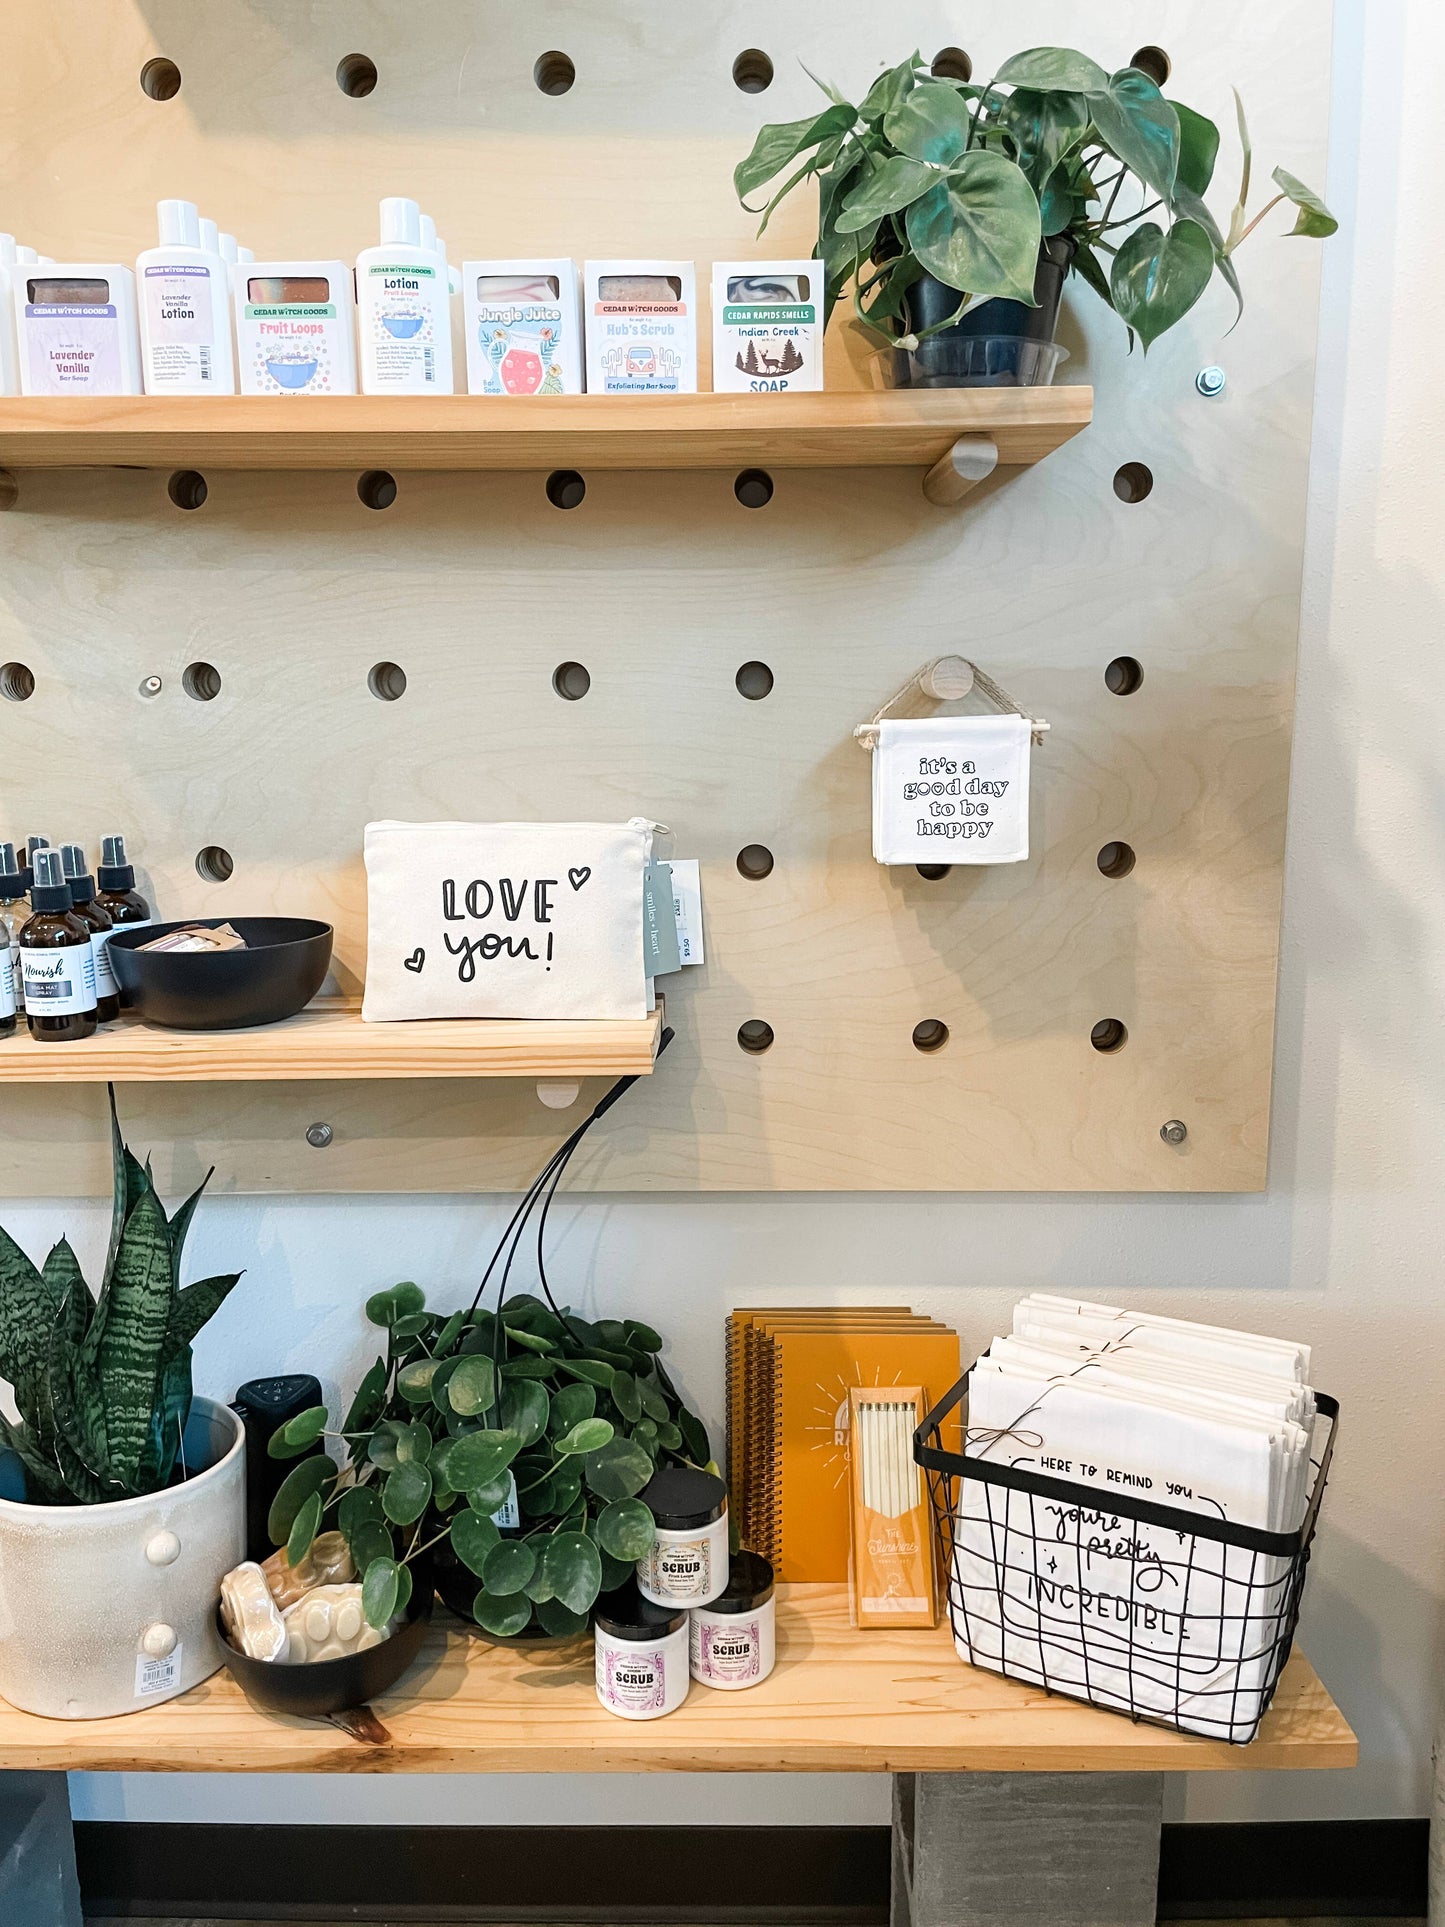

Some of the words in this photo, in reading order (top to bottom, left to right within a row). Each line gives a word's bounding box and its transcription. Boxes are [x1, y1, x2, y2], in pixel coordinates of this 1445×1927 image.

[384, 277, 419, 289] Lotion
[33, 307, 57, 315] CEDAR
[83, 307, 109, 315] GOODS
[162, 308, 194, 319] Lotion
[478, 307, 523, 327] Jungle
[525, 306, 561, 322] Juice
[728, 312, 751, 320] CEDAR
[753, 311, 780, 319] RAPIDS
[782, 311, 809, 319] SMELLS
[260, 322, 288, 334] Fruit
[290, 323, 324, 336] Loops
[607, 324, 638, 336] Hub's
[640, 324, 674, 336] Scrub
[739, 327, 769, 336] Indian
[772, 326, 799, 336] Creek
[50, 350, 94, 360] Lavender
[56, 363, 90, 373] Vanilla
[750, 380, 788, 392] SOAP
[920, 757, 957, 774] it's
[962, 761, 976, 774] a
[904, 778, 961, 800] good
[965, 778, 1009, 798] day
[929, 801, 956, 817] to
[960, 799, 989, 816] be
[917, 819, 994, 839] happy
[442, 878, 558, 922] LOVE
[646, 891, 657, 922] smiles
[650, 929, 661, 956] heart
[683, 938, 691, 957] $9.50
[444, 932, 553, 983] you!
[25, 958, 64, 978] Nourish
[1041, 1456, 1072, 1473] HERE
[1080, 1464, 1098, 1476] TO
[1106, 1469, 1153, 1488] REMIND
[886, 1528, 902, 1538] THE
[662, 1562, 700, 1573] SCRUB
[1087, 1536, 1178, 1592] pretty
[1027, 1576, 1191, 1640] INCREDIBLE
[713, 1644, 750, 1655] SCRUB
[616, 1672, 654, 1684] SCRUB
